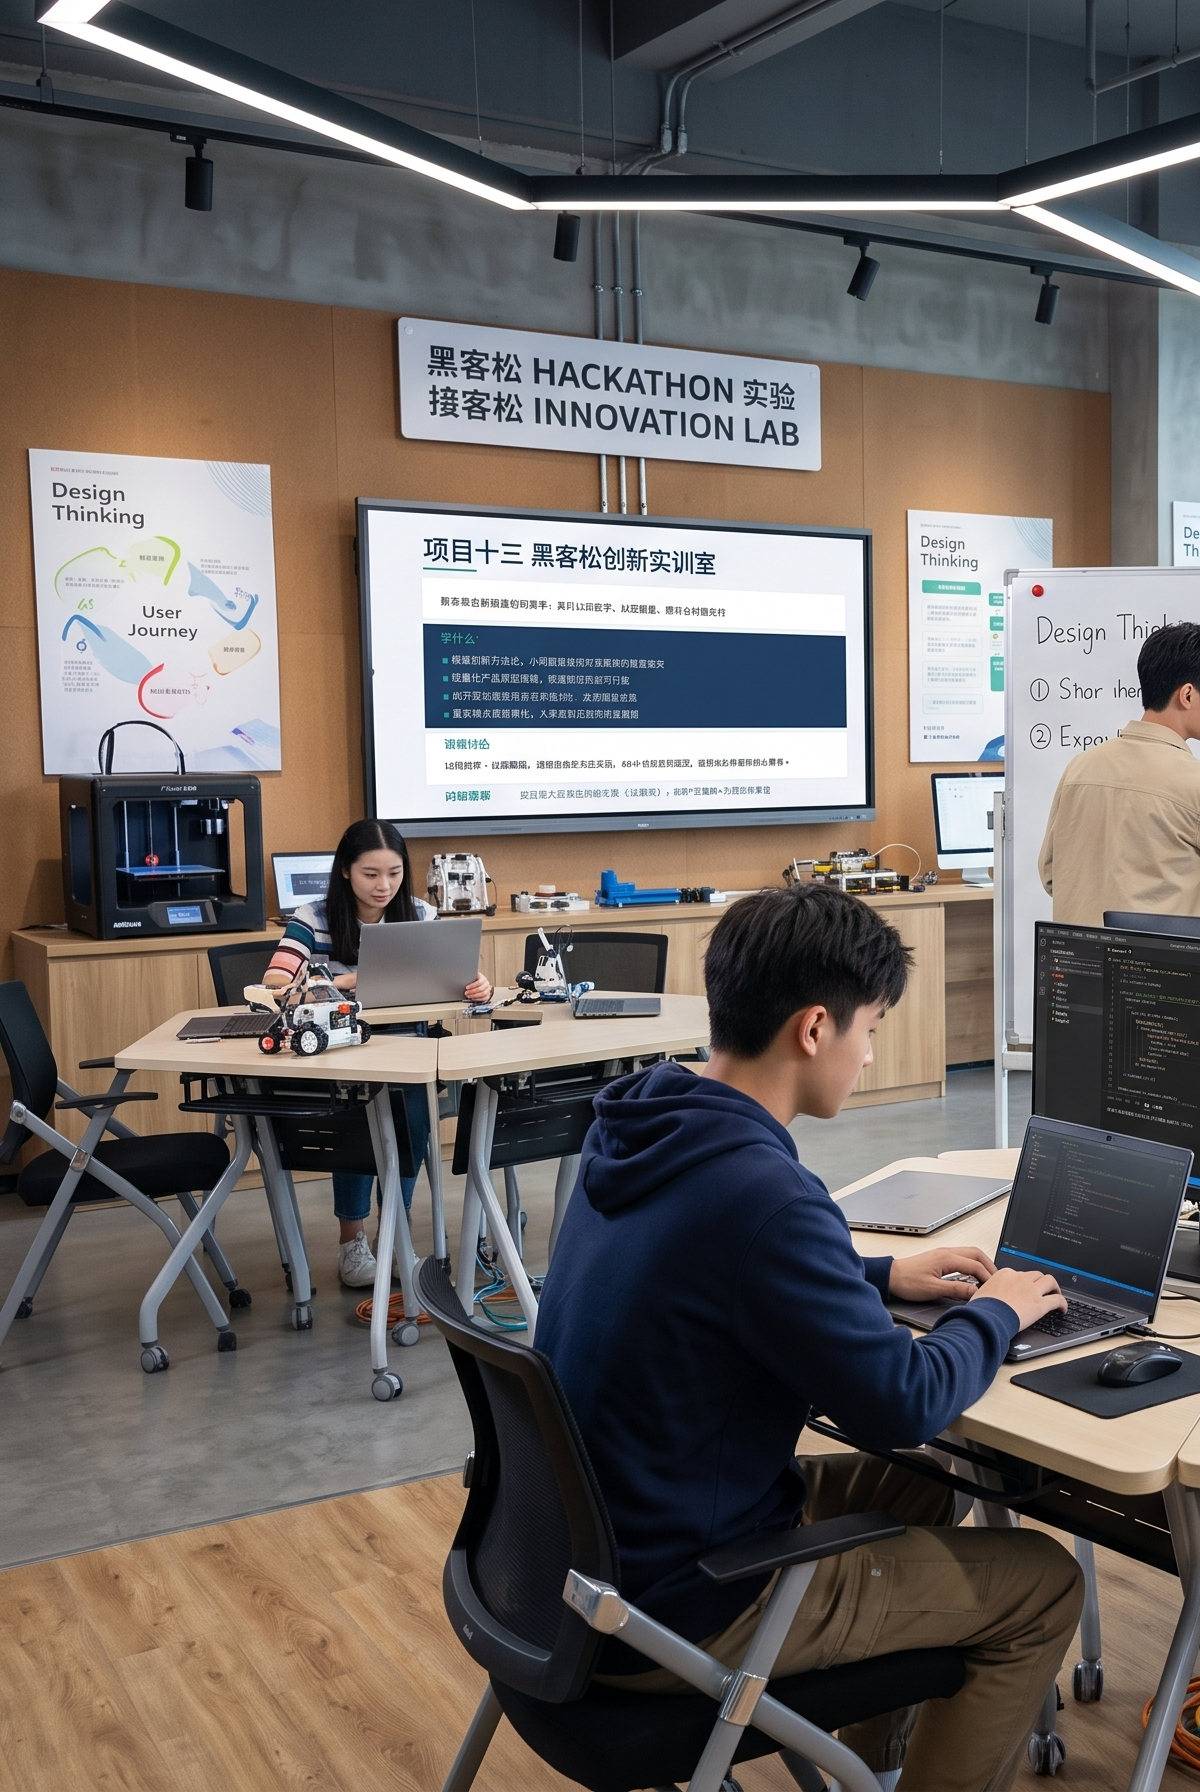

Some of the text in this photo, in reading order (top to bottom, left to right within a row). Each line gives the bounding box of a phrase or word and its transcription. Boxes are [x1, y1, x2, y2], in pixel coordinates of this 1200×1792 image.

[428, 345, 795, 410] 黑客松 HACKATHON 实验
[429, 385, 799, 446] 接客松 INNOVATION LAB
[52, 482, 125, 505] Design
[52, 505, 145, 530] Thinking
[921, 536, 964, 552] Design
[424, 538, 715, 575] 项目十三 黑客松创新实训室
[921, 553, 978, 571] Thinking
[142, 606, 182, 619] User
[128, 624, 197, 641] Journey
[1037, 616, 1105, 654] Design
